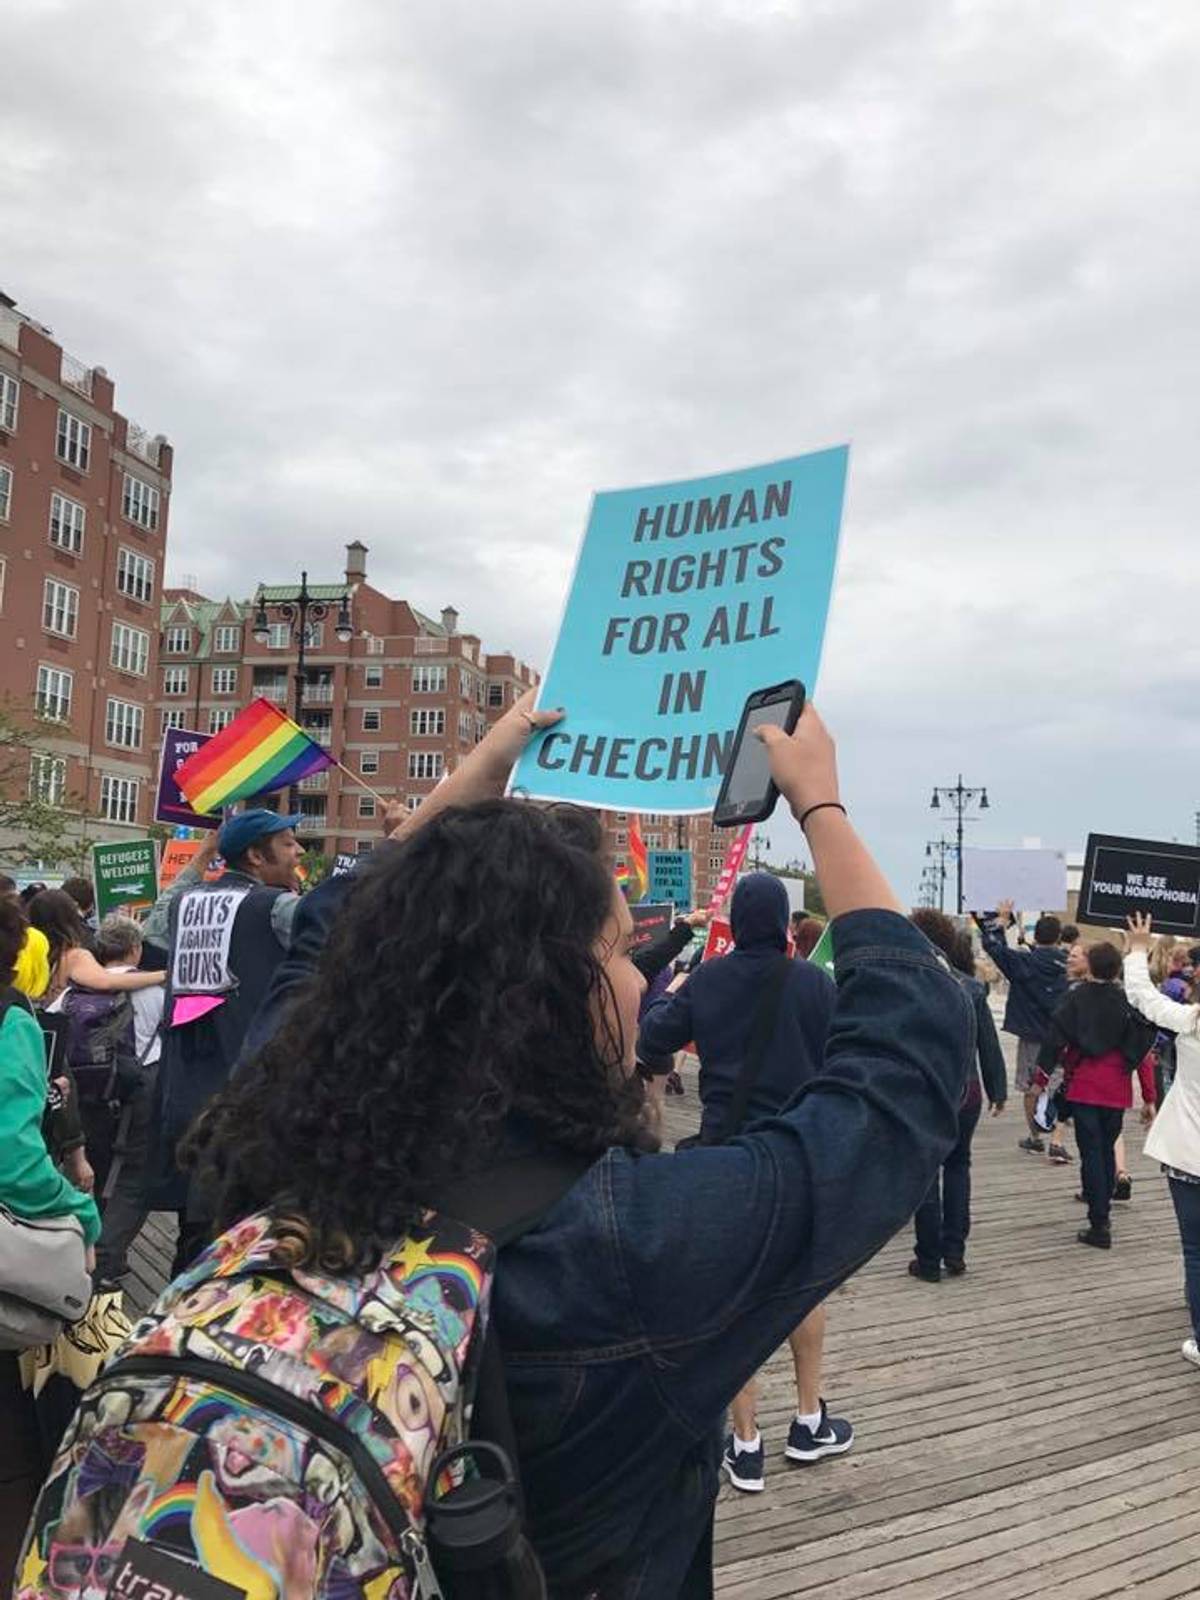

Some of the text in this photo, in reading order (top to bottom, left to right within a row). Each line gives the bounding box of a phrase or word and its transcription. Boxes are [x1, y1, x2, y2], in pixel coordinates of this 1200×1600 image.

[633, 480, 793, 542] HUMAN
[620, 537, 786, 598] RIGHTS
[602, 596, 781, 655] FOR ALL
[658, 670, 706, 715] IN
[100, 849, 151, 866] REFUGEES
[101, 863, 151, 879] WELCOME
[1093, 881, 1198, 904] YOUR HOMOPHOBIA
[1126, 872, 1167, 888] WE SEE
[183, 895, 234, 928] GAYS
[180, 928, 224, 949] AGAINST
[178, 951, 222, 985] GUNS
